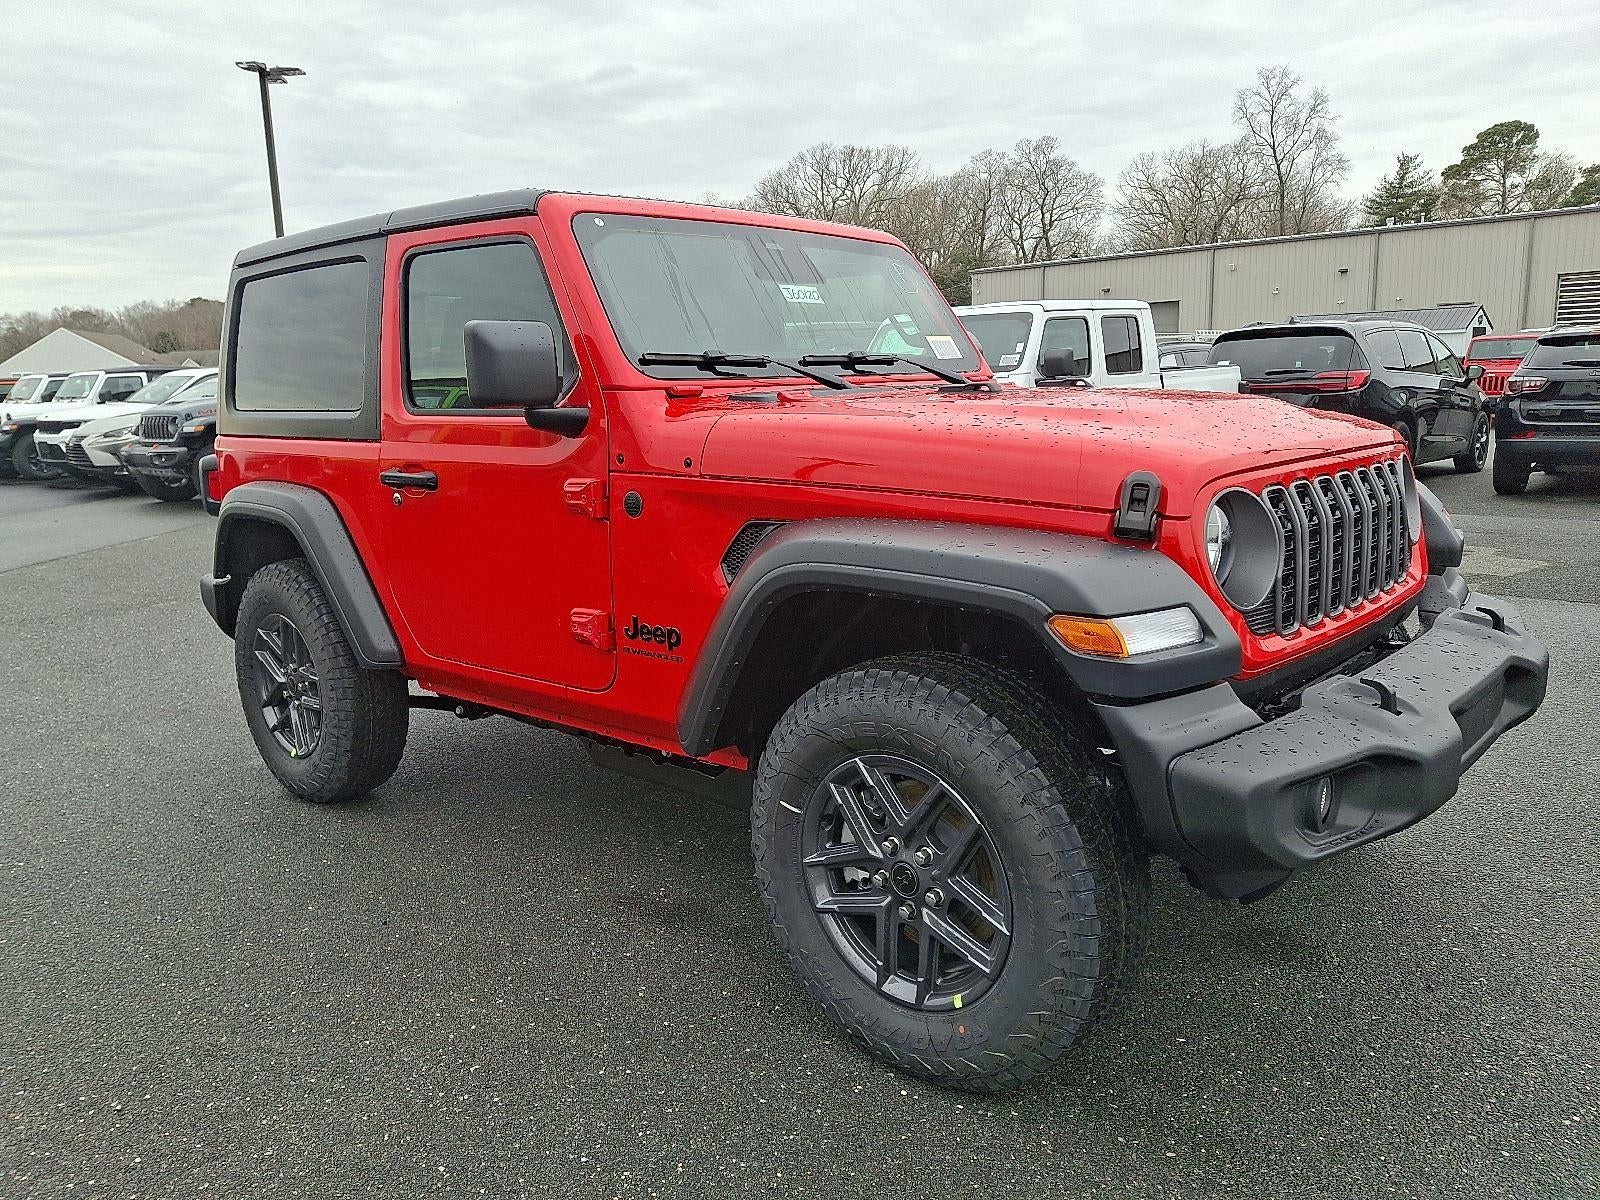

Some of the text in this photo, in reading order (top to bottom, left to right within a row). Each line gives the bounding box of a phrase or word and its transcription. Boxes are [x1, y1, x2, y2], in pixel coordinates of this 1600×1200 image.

[623, 614, 682, 651] Jeep
[630, 648, 684, 663] WRANGLER
[831, 721, 966, 779] NEXEN
